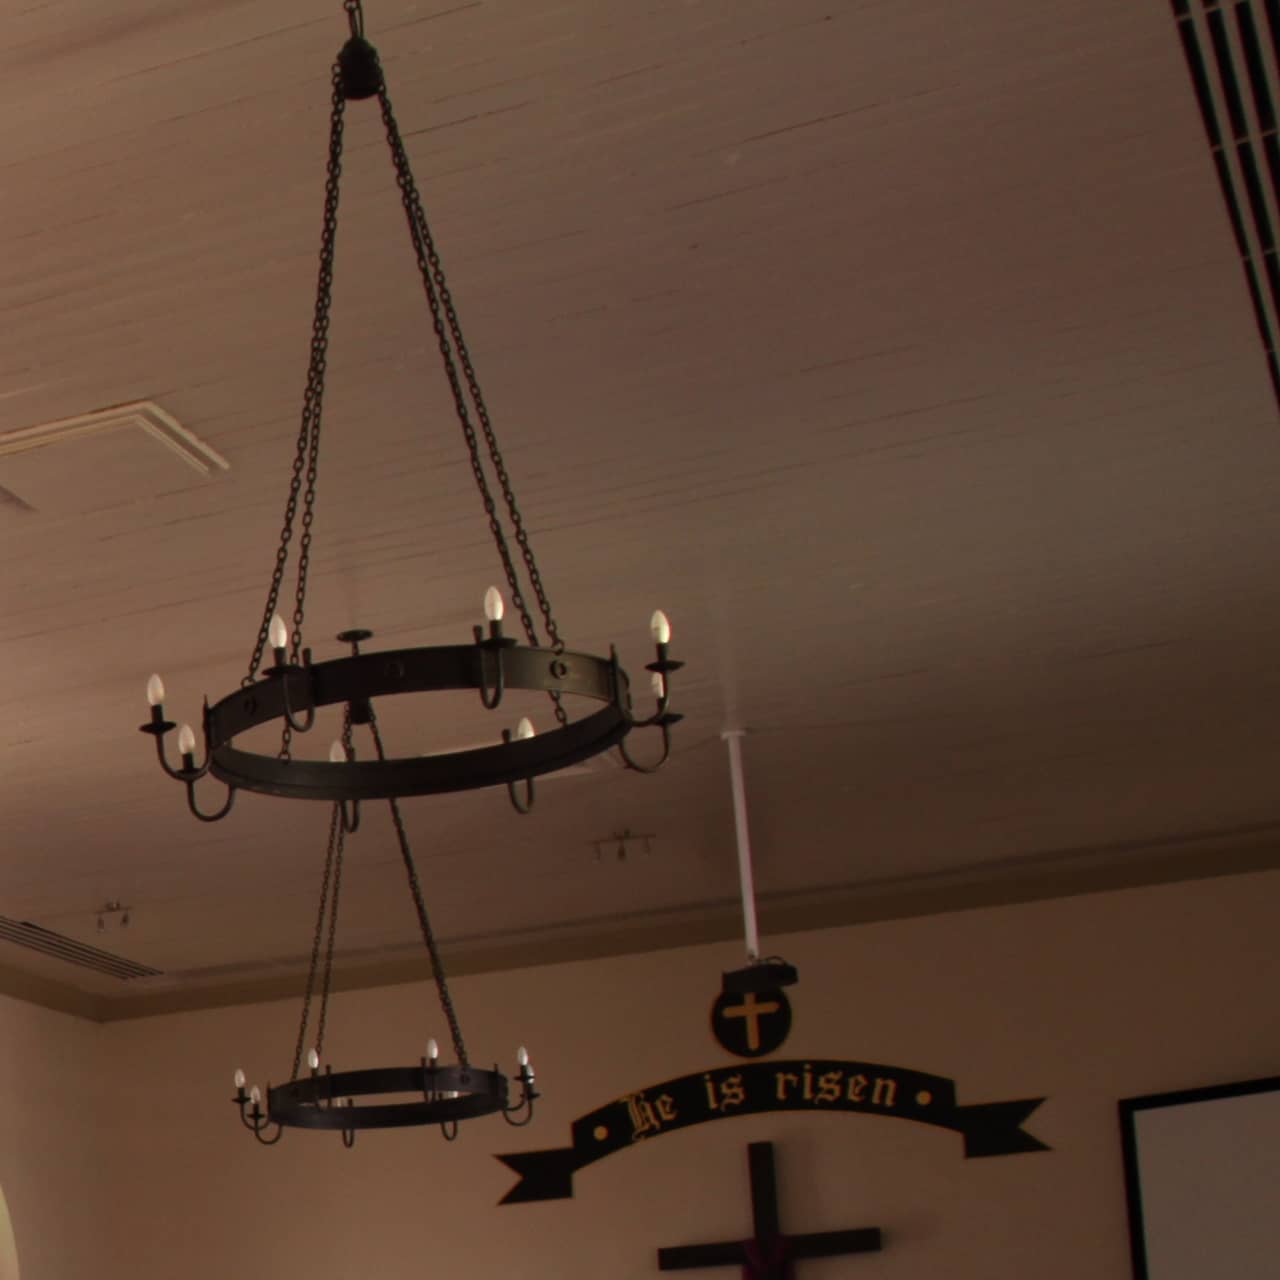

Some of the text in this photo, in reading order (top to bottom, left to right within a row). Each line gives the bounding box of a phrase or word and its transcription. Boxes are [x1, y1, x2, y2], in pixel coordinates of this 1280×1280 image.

[626, 1064, 898, 1140] He is risen
